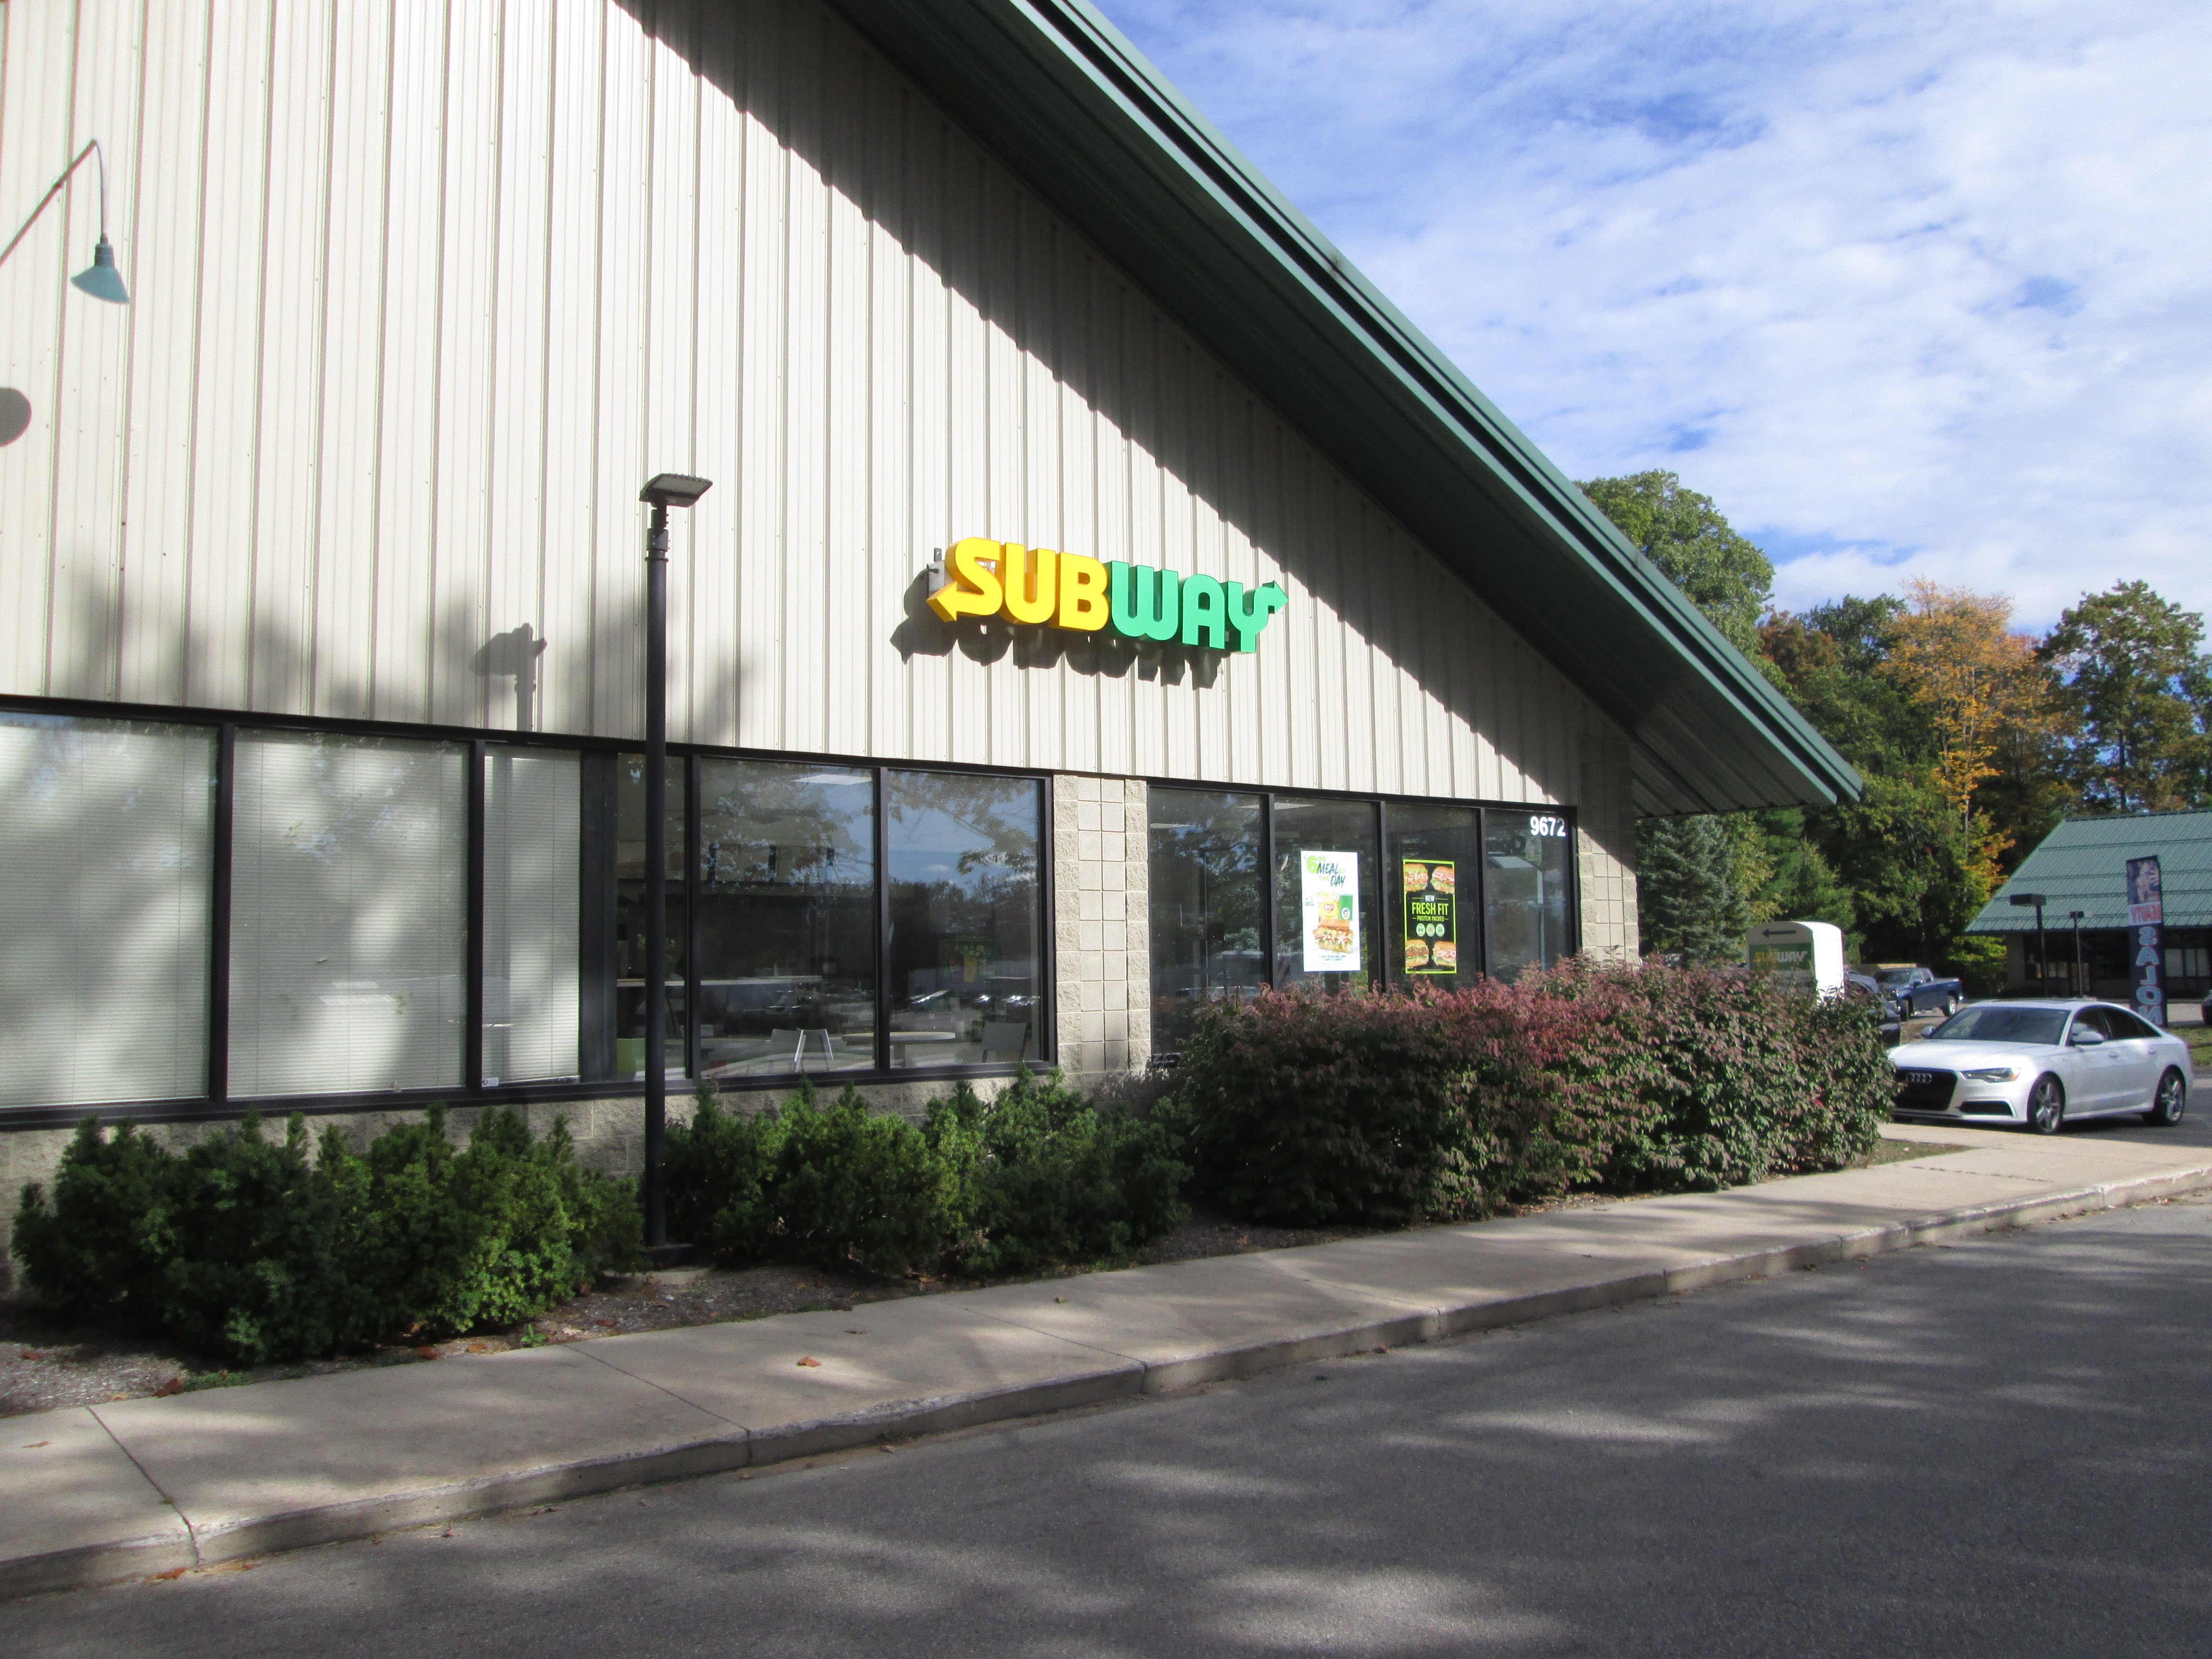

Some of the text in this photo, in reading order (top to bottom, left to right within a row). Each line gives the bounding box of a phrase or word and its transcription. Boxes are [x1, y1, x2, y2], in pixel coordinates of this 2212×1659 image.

[926, 537, 1289, 653] SUBWAY
[1530, 816, 1566, 836] 9672
[1316, 862, 1339, 875] MEAL
[1330, 875, 1346, 889] DAY
[1412, 902, 1449, 915] FRESH FIT
